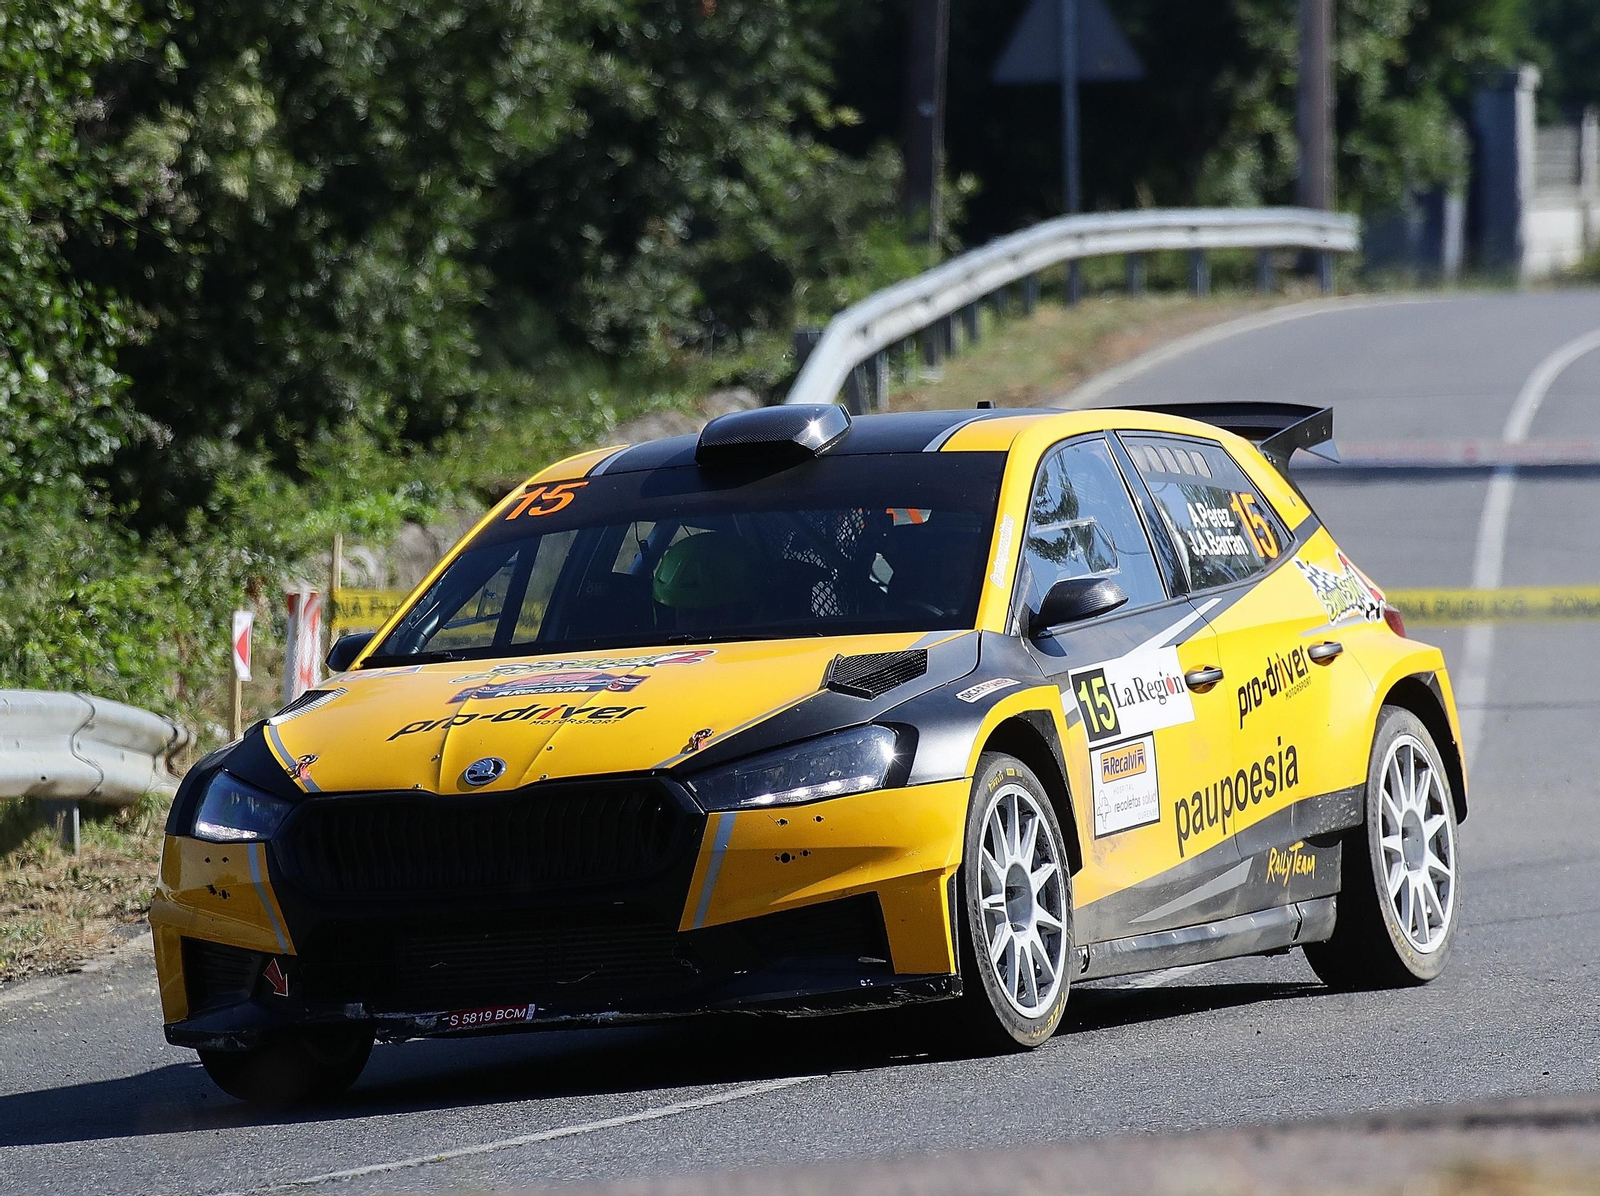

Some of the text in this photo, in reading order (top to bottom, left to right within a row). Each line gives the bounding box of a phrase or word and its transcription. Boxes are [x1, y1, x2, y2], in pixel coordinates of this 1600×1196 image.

[504, 481, 590, 521] 15
[1186, 501, 1236, 528] A.Pérez
[1229, 491, 1279, 559] 15
[1078, 675, 1116, 733] 15
[1109, 670, 1185, 709] La Región
[1237, 644, 1309, 730] pro-driver
[384, 702, 648, 742] pro-driver
[528, 717, 622, 727] MOTORSPORT
[1109, 749, 1138, 776] Recalvi
[1113, 793, 1141, 814] recoletas
[1174, 735, 1300, 859] paupoesia
[449, 1014, 459, 1026] S
[461, 1010, 493, 1025] 5819
[495, 1007, 527, 1020] BCM
